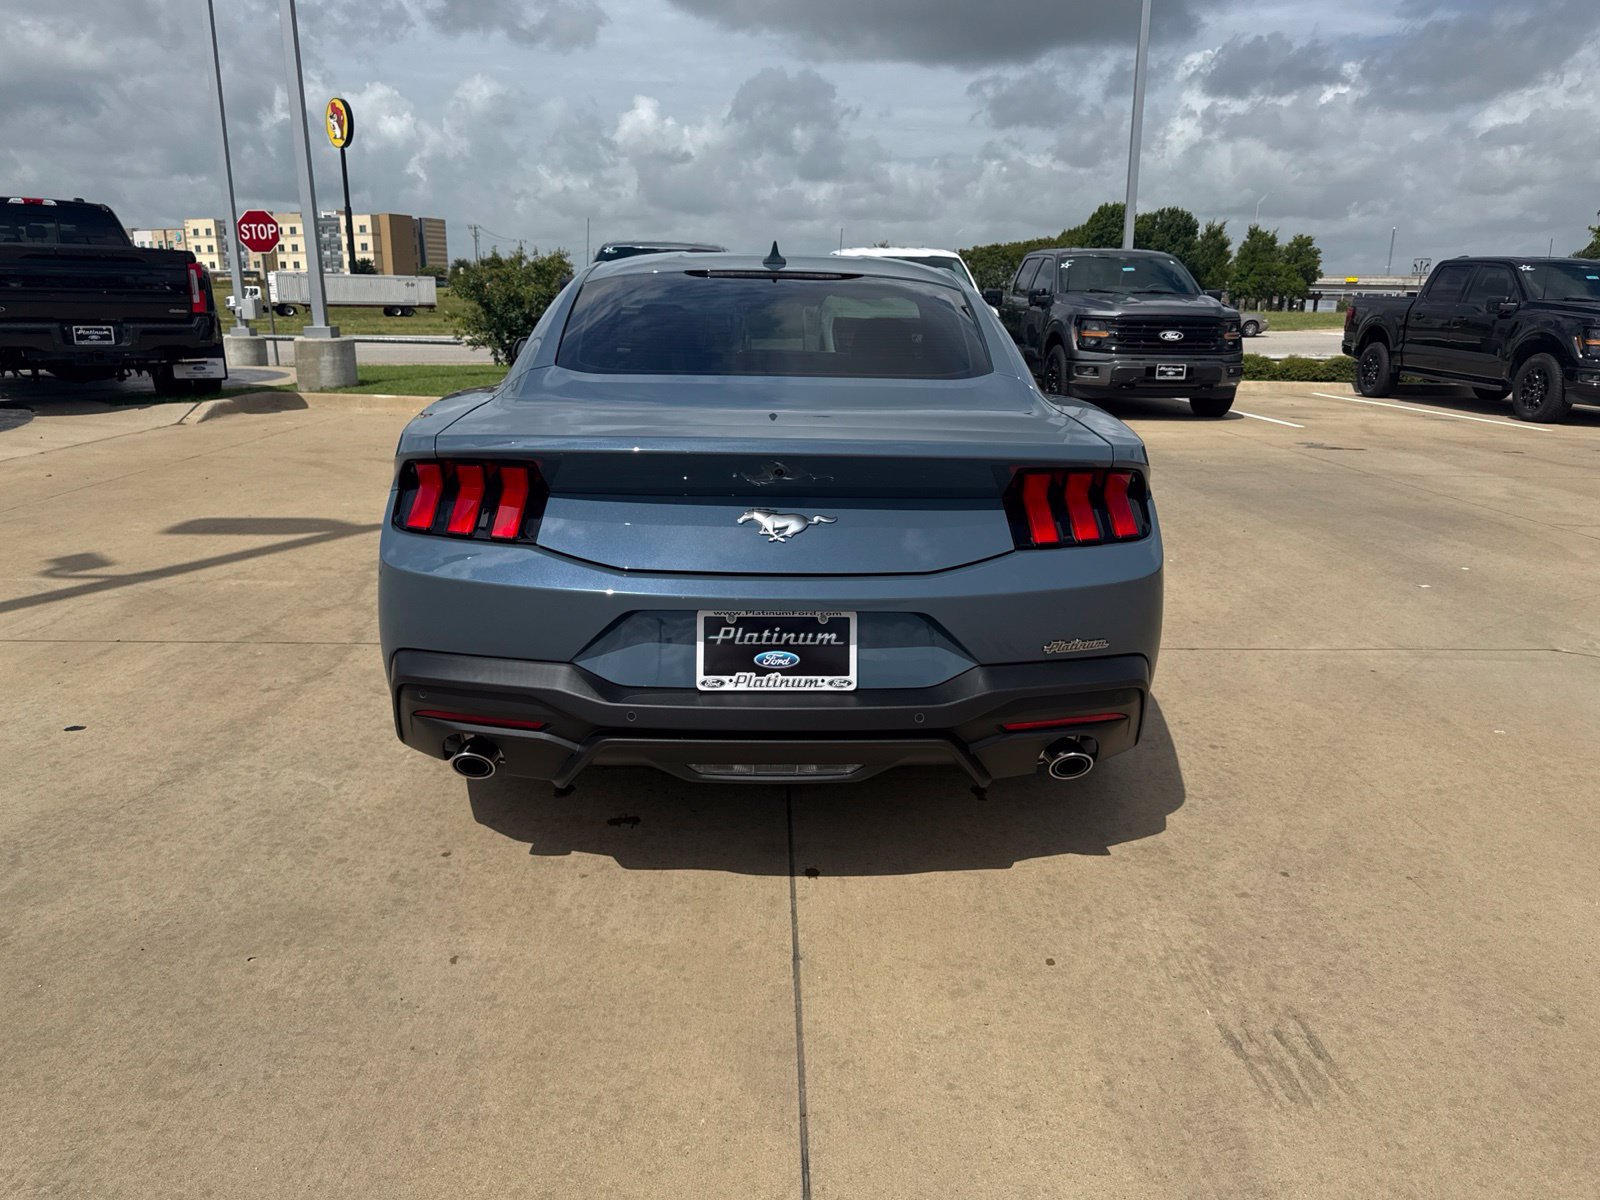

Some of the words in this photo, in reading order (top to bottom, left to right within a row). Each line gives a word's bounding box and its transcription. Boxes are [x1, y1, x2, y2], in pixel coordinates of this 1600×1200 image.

[241, 223, 277, 240] STOP
[707, 627, 845, 645] Platinum
[1043, 639, 1109, 654] Platinum
[762, 653, 791, 667] Ford
[733, 674, 825, 688] Platinum
